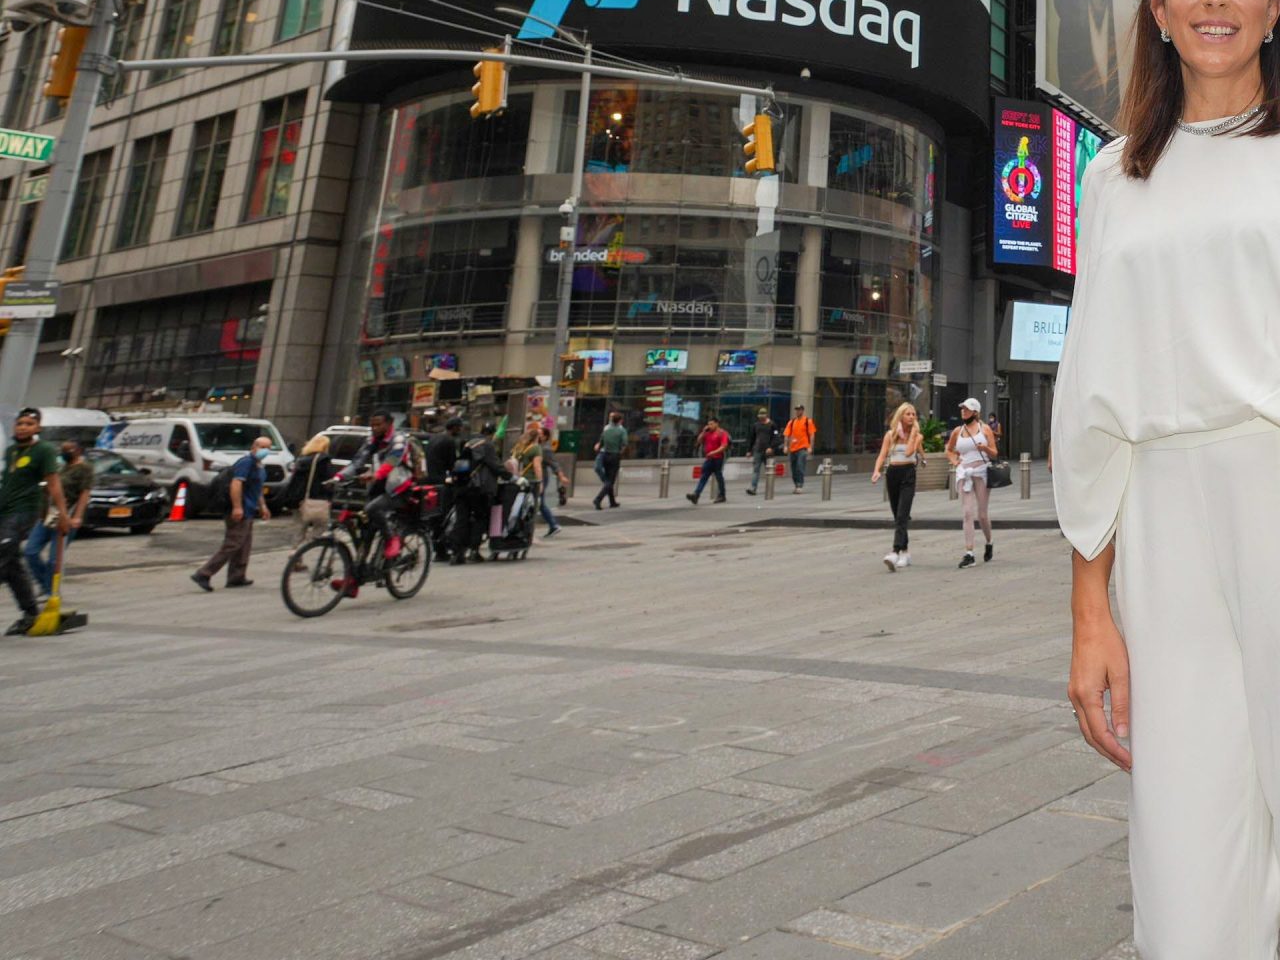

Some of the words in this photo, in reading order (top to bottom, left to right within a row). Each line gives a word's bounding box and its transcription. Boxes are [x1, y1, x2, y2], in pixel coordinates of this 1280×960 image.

[1004, 203, 1038, 215] GLOBAL
[1012, 221, 1031, 229] LIVE
[656, 300, 713, 317] Nasdaq
[1033, 321, 1064, 335] BRILL
